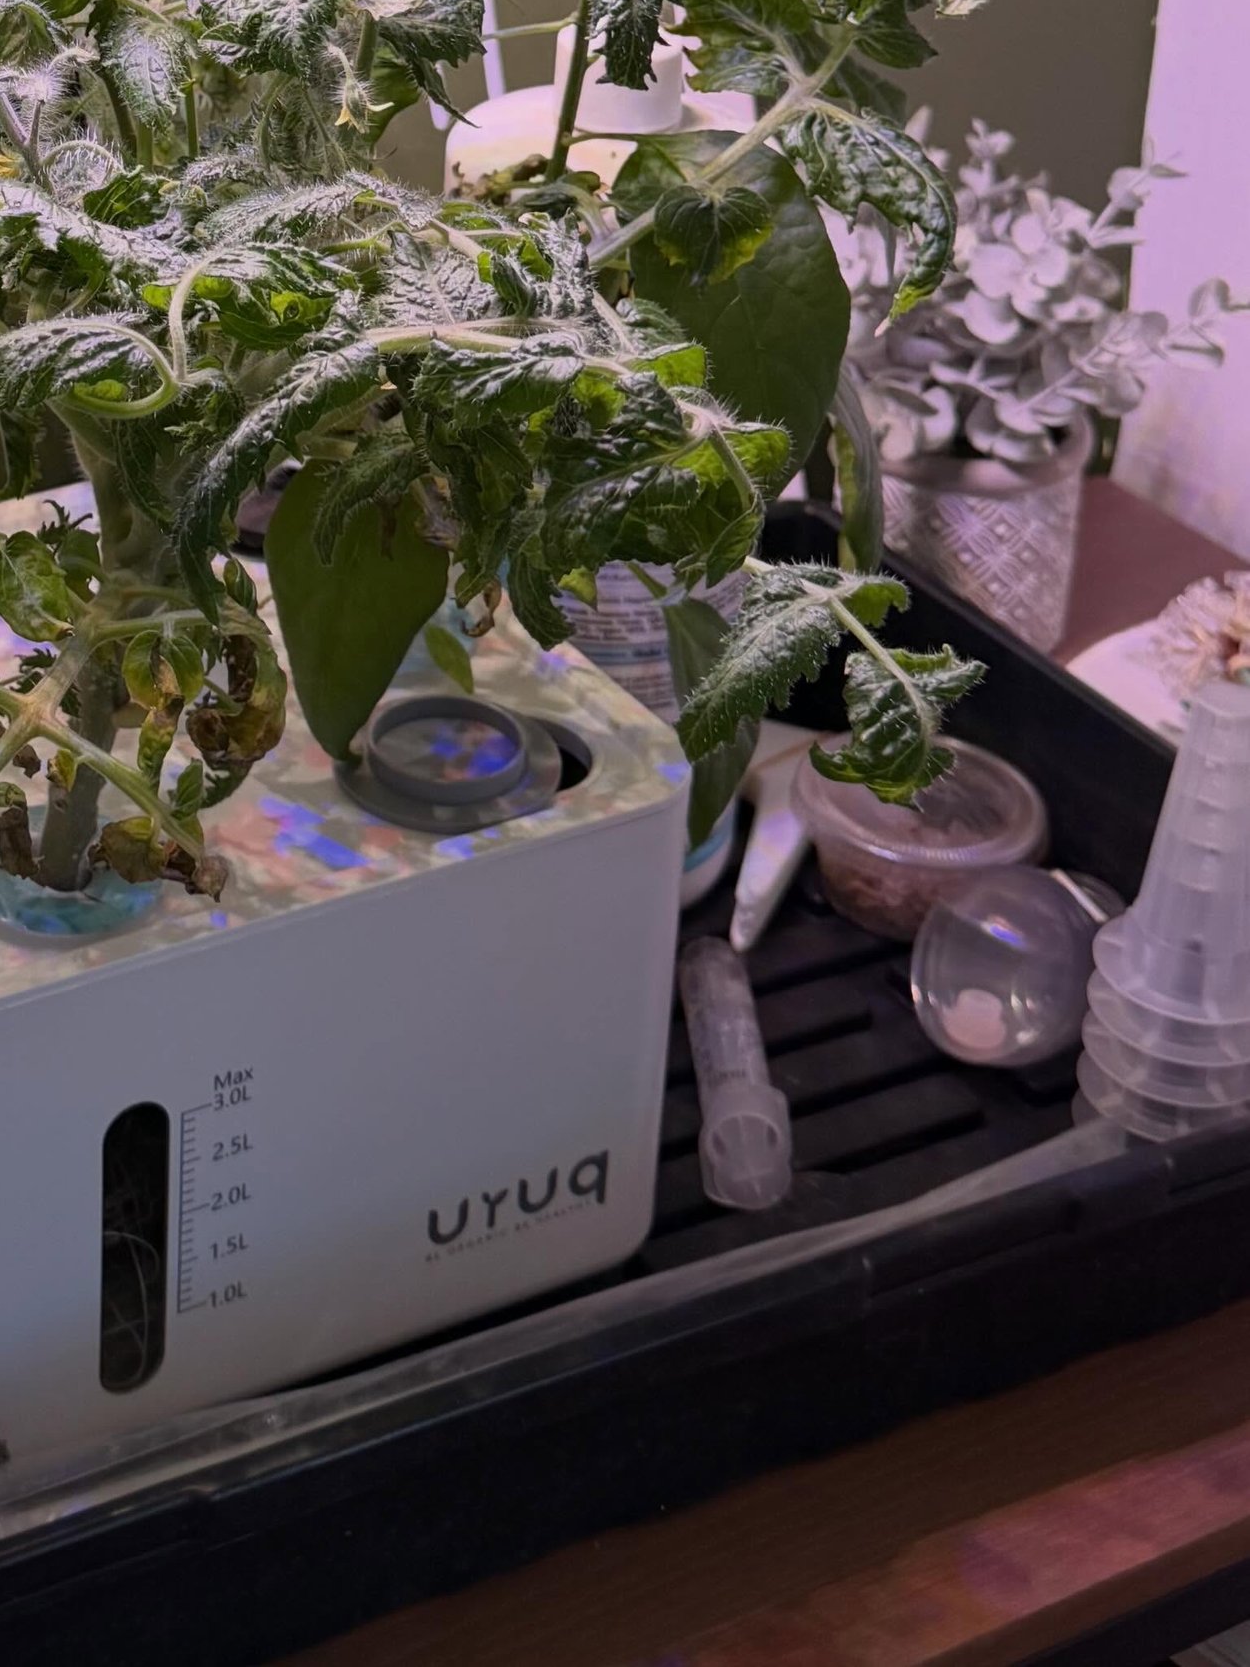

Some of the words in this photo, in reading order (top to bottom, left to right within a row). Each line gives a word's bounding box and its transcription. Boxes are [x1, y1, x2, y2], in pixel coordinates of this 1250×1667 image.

[213, 1066, 254, 1091] Max
[213, 1085, 251, 1111] 3.0L
[212, 1133, 253, 1161] 2.5L
[210, 1184, 251, 1211] 2.0L
[210, 1233, 249, 1260] 1.5L
[208, 1281, 247, 1309] 1.0L
